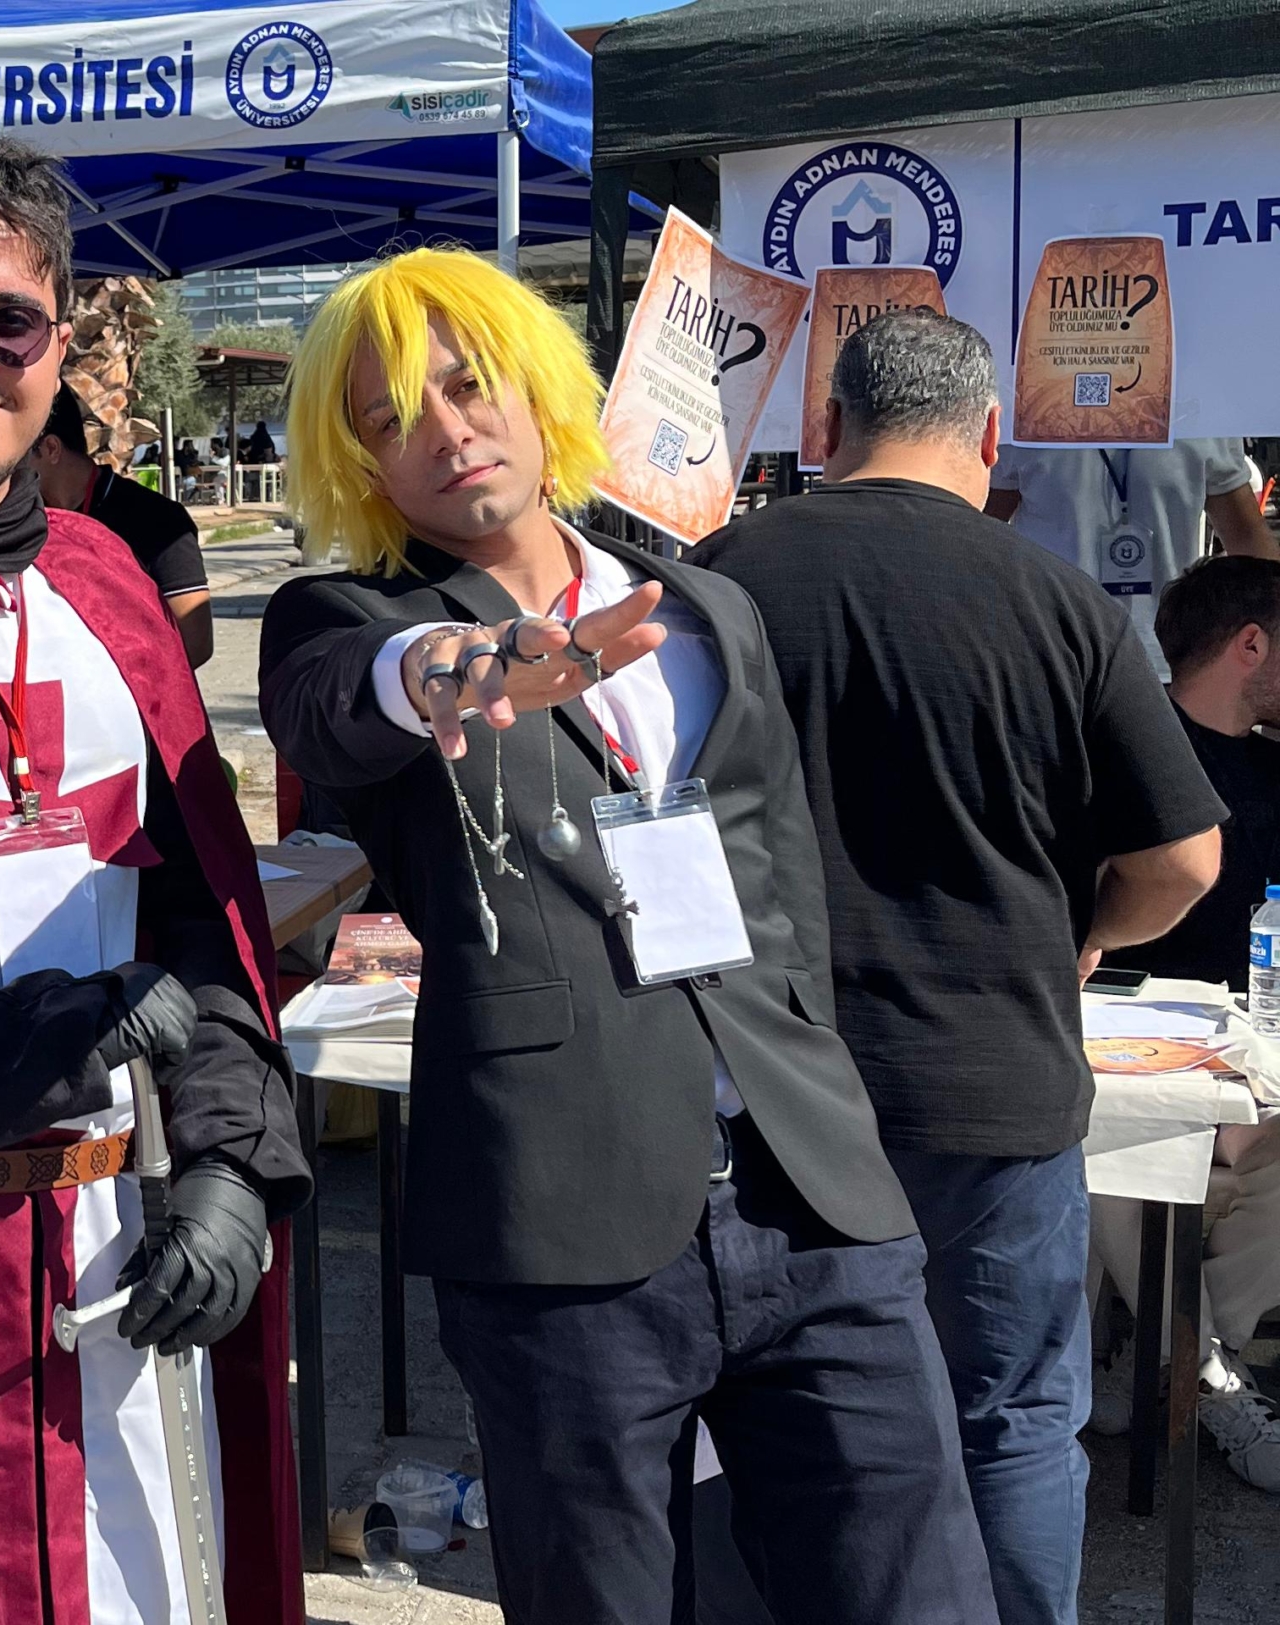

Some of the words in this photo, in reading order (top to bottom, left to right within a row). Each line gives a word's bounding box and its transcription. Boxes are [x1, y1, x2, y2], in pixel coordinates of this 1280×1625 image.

[229, 53, 244, 94] AYDIN
[241, 25, 289, 52] ADNAN
[291, 26, 330, 92] MENDERES
[770, 199, 797, 272] AYDIN
[793, 149, 878, 198] ADNAN
[885, 152, 956, 266] MENDERES
[1047, 270, 1130, 308] TARİH
[1049, 309, 1122, 321] TOPLULUĞUMUZA
[1049, 321, 1064, 332] ÜYE
[1066, 322, 1103, 332] OLDUNUZ
[1105, 321, 1117, 331] MU
[1111, 346, 1120, 355] VE
